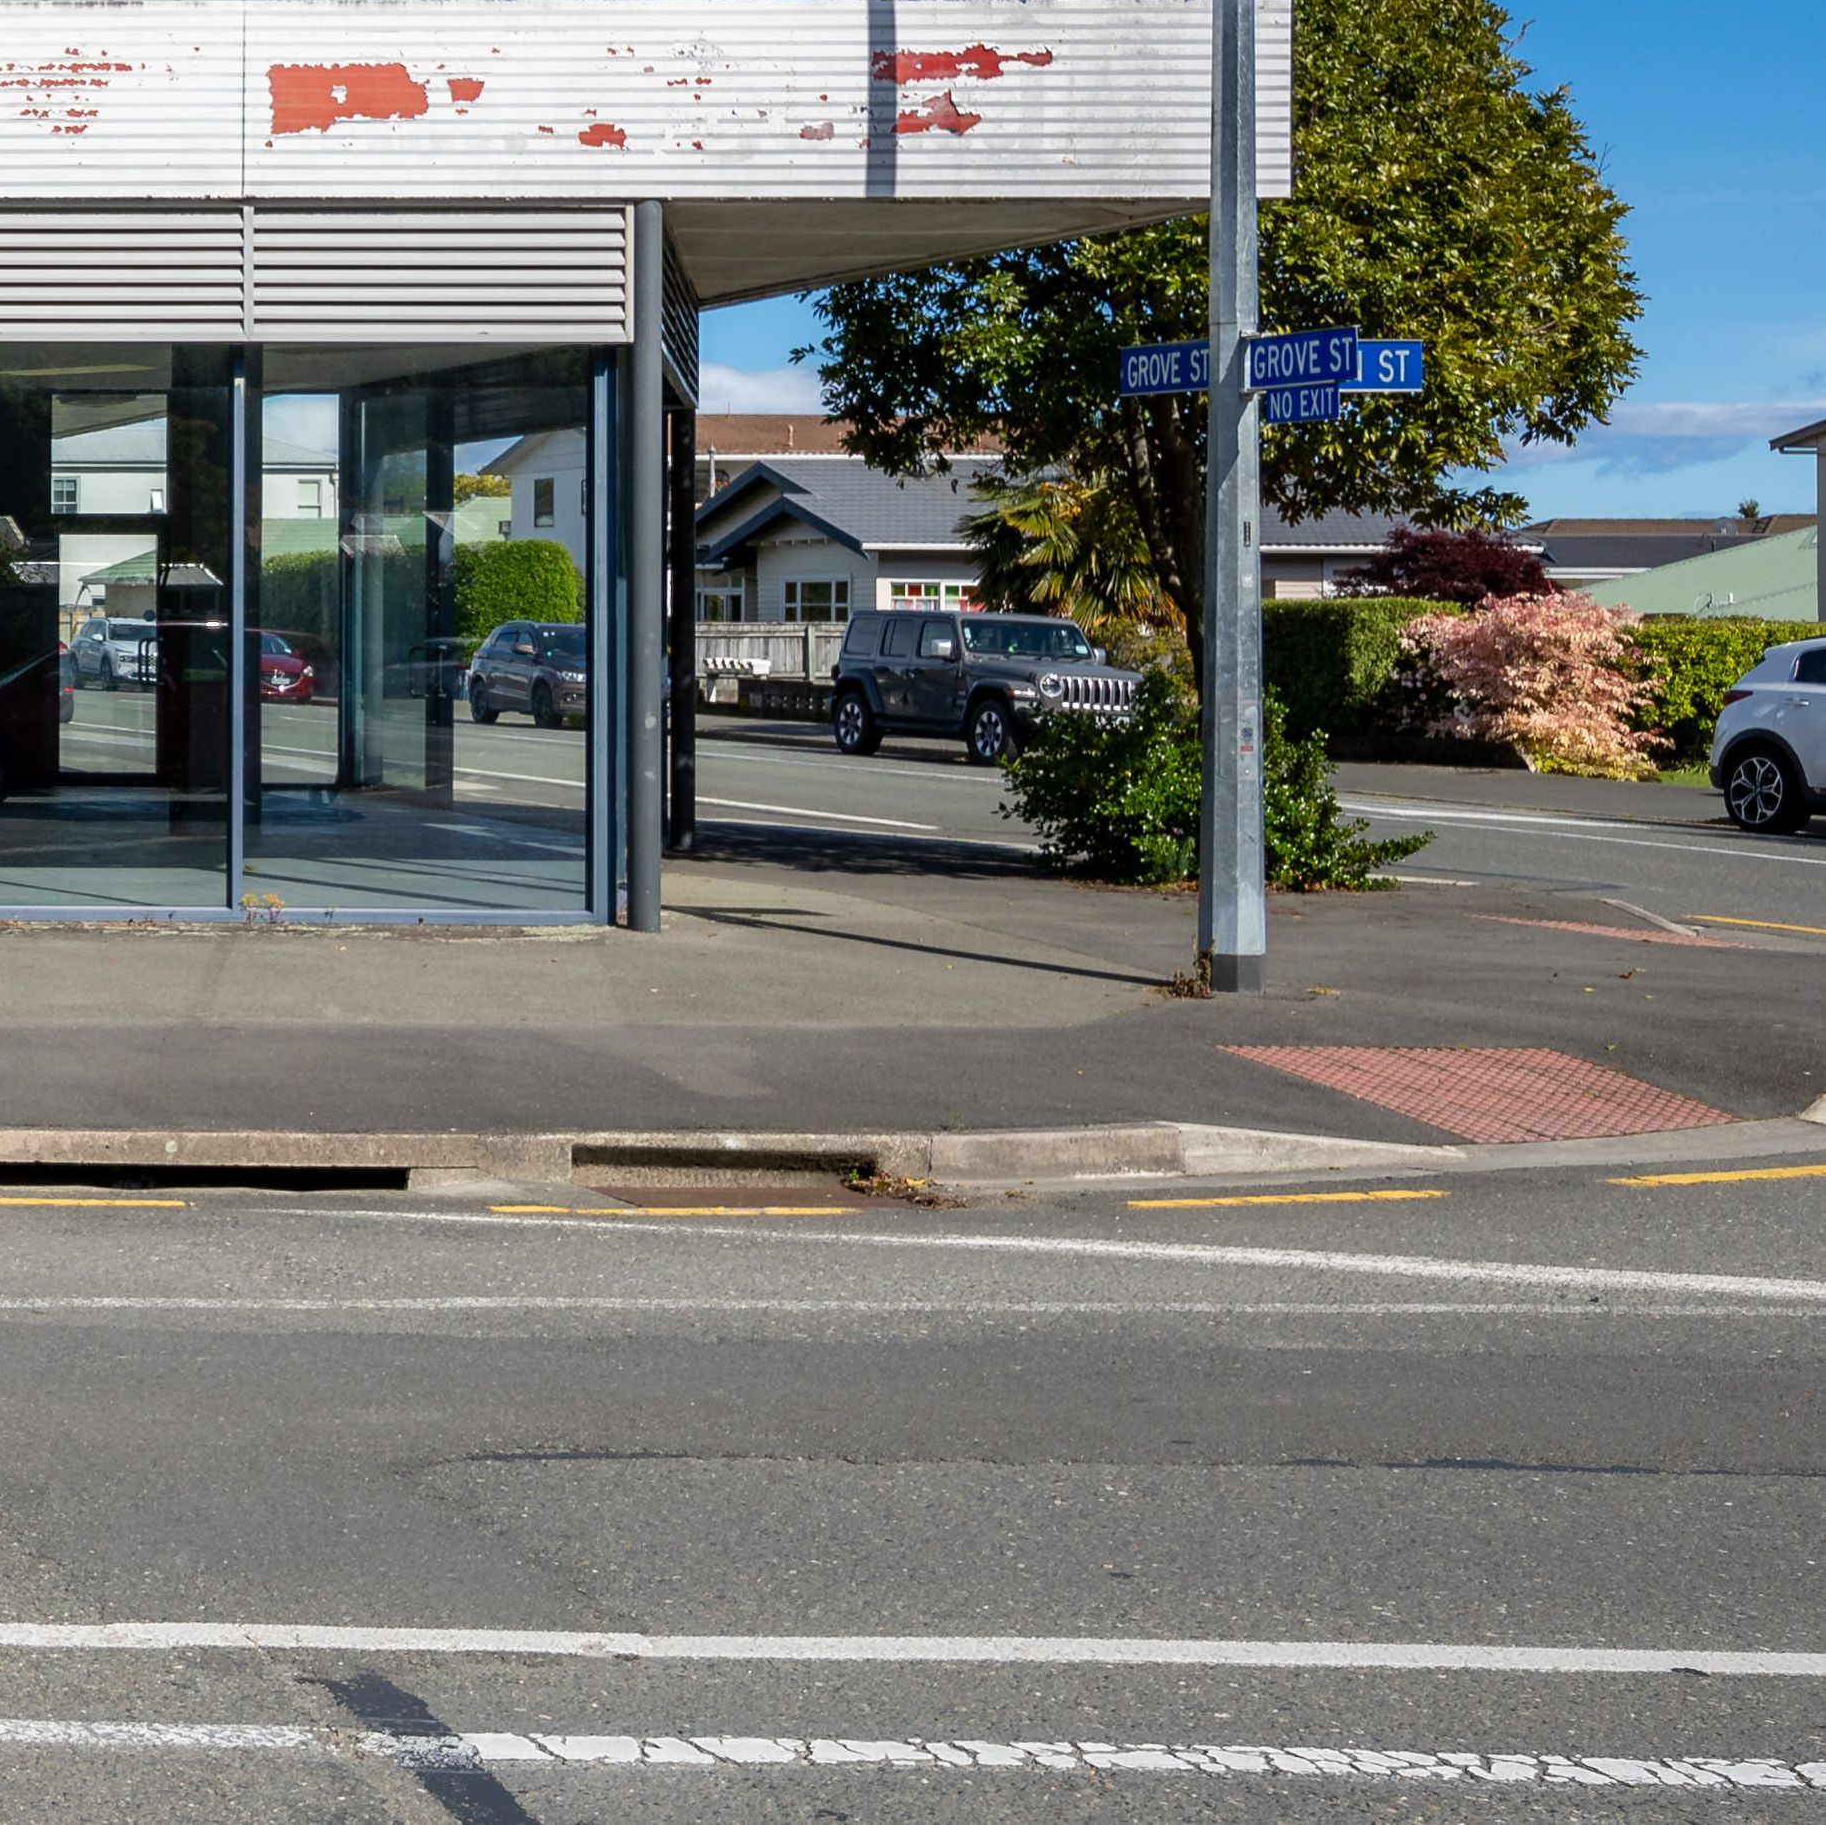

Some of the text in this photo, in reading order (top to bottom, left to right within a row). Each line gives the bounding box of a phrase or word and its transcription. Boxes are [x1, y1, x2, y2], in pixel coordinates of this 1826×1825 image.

[1127, 349, 1209, 388] GROVE ST
[1254, 340, 1321, 380] GROVE
[1329, 337, 1353, 372] ST
[1378, 349, 1410, 383] ST
[1270, 387, 1335, 420] NO EXIT
